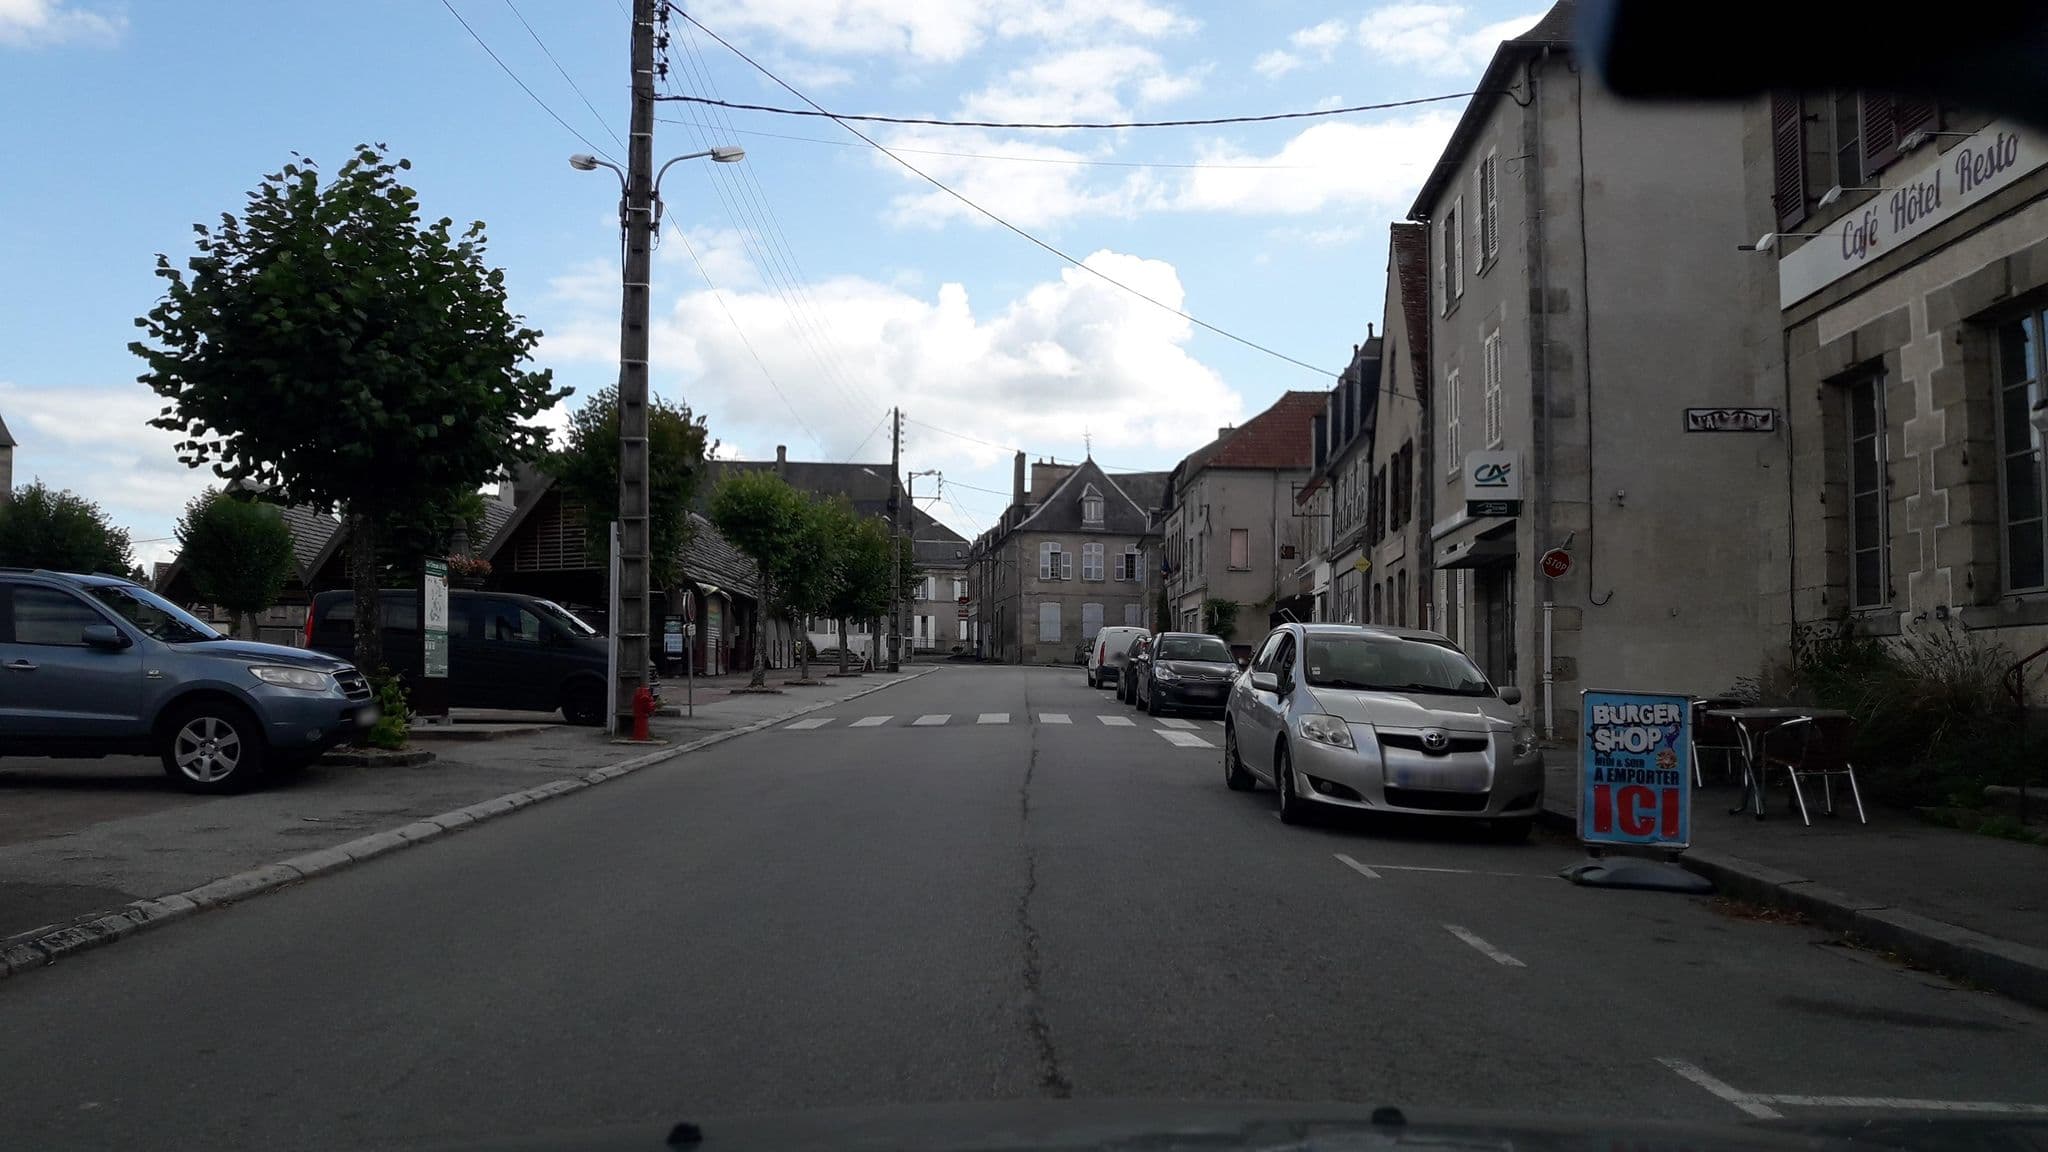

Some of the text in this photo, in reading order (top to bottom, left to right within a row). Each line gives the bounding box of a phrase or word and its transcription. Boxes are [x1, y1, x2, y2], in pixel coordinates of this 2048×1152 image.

[1842, 132, 2019, 260] Café Hôtel Resto
[1545, 557, 1568, 571] STOP
[1592, 703, 1680, 725] BURGER
[1593, 726, 1662, 753] SHOP
[1606, 769, 1680, 785] EMPORTER
[1593, 784, 1680, 838] ICI
